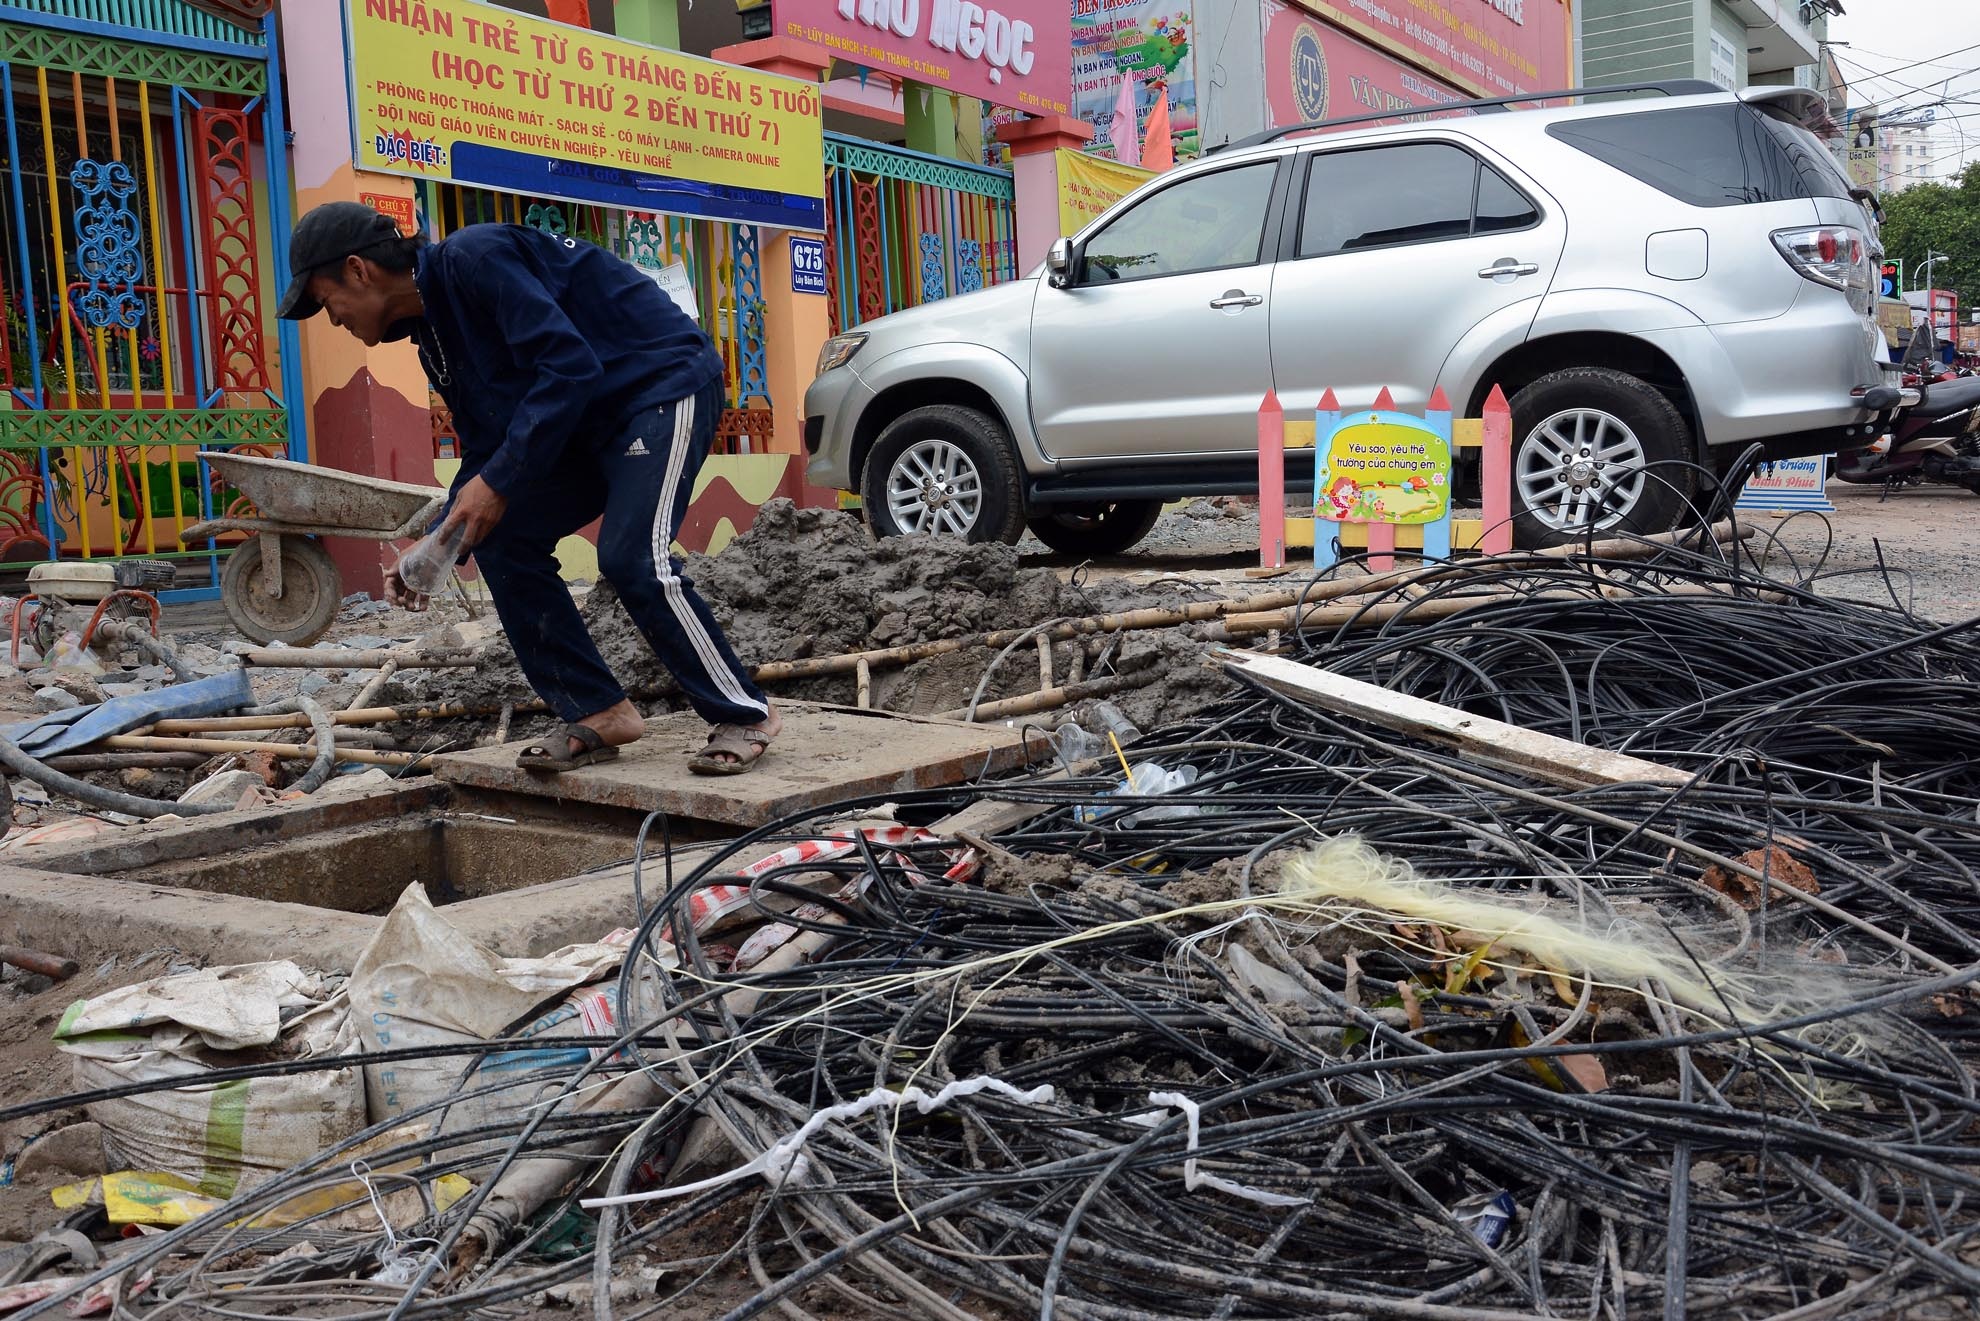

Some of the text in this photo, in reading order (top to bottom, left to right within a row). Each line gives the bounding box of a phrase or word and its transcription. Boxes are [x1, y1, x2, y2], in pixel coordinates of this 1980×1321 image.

[787, 22, 802, 37] 675
[927, 0, 1034, 86] NGỌC
[365, 0, 819, 117] NHẬN TRẺ TỪ 6 THÁNG ĐẾN 5 TUỔI
[431, 50, 780, 145] (HỌC TỪ THỨ 2 ĐẾN THỨ 7)
[1349, 74, 1382, 111] VĂN
[376, 80, 426, 103] PHÒNG
[429, 91, 458, 110] HỌC
[461, 98, 515, 122] THOÁNG
[518, 109, 545, 127] MÁT
[556, 118, 588, 136] SẠCH
[617, 127, 633, 143] CÓ
[637, 130, 660, 148] MÁY
[664, 138, 692, 154] LẠNH
[702, 145, 743, 163] CAMERA
[746, 152, 780, 167] ONLINE
[377, 103, 672, 169] ĐỘI NGŨ GIÁO VIÊN CHUYÊN NGHIỆP YÊU NGHỀ
[375, 134, 447, 166] ĐẶC BIỆT:
[379, 200, 398, 211] CHÚ
[794, 245, 822, 270] 675
[1337, 457, 1436, 471] trường của chúng em
[1349, 443, 1367, 454] Yêu
[1369, 445, 1388, 455] sao,
[1390, 445, 1408, 455] yêu
